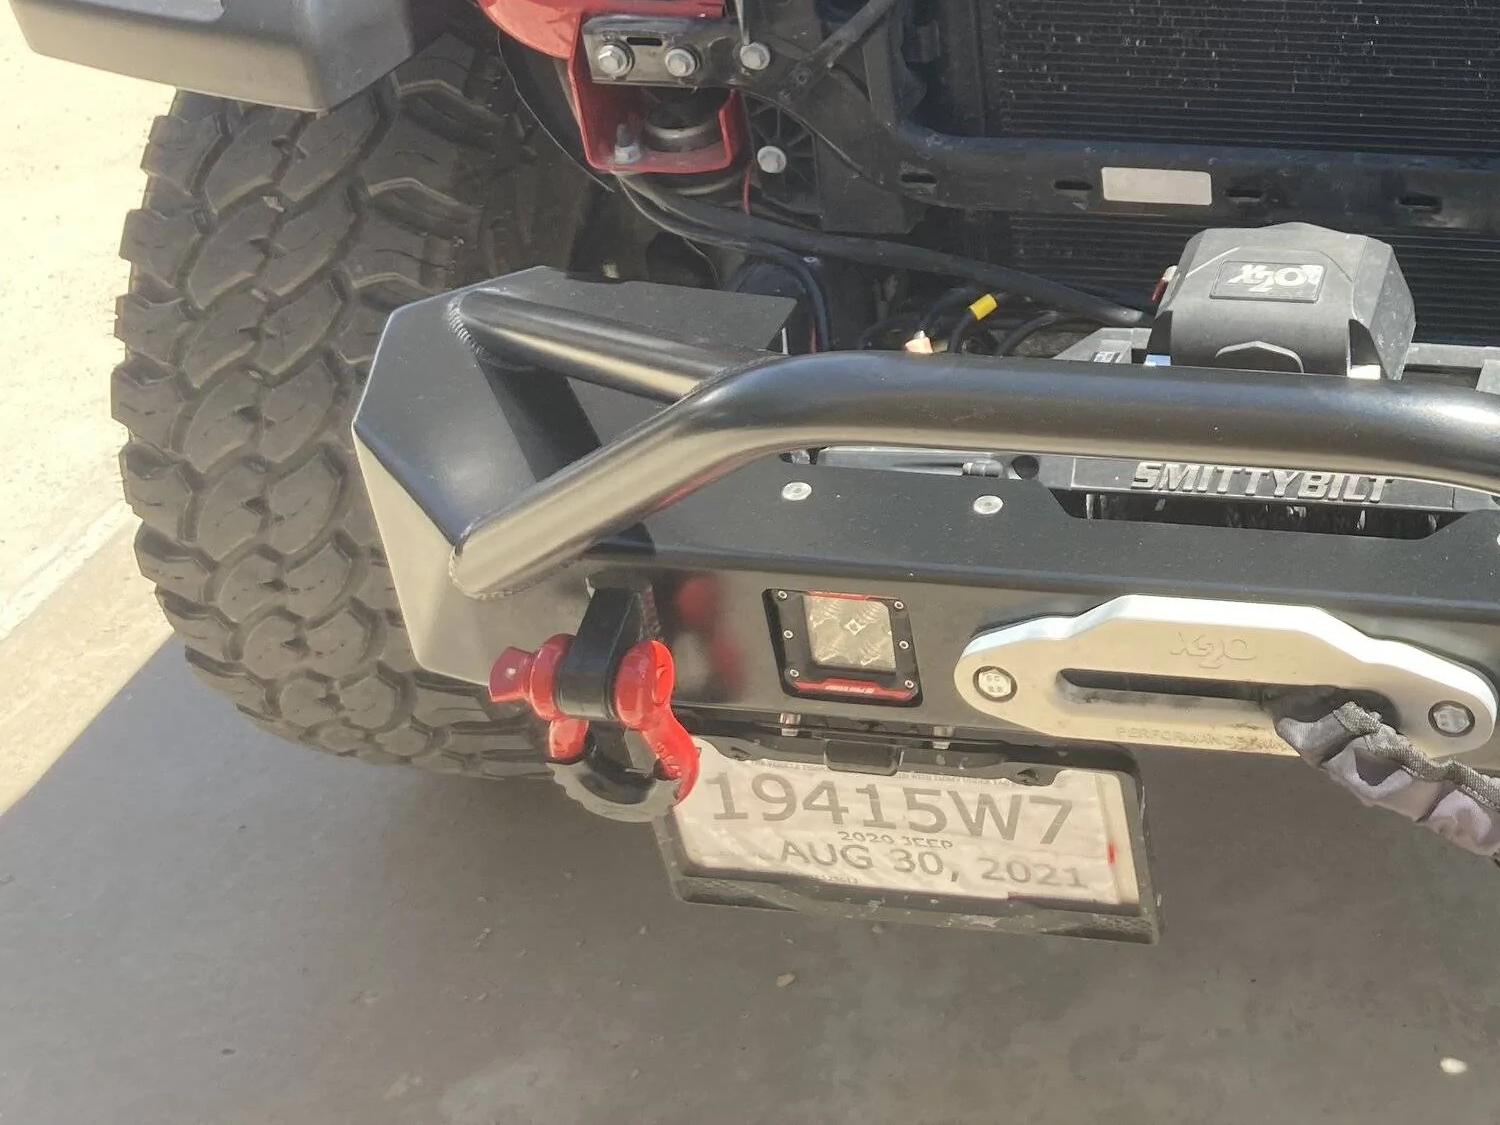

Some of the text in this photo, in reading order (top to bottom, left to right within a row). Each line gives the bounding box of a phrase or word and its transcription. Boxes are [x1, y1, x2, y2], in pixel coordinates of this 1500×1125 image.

[1131, 461, 1395, 504] SMITTYBILT
[705, 771, 1074, 845] 19415W7
[838, 831, 954, 850] 2020 JEEP
[780, 839, 1088, 889] AUG 30, 2021
